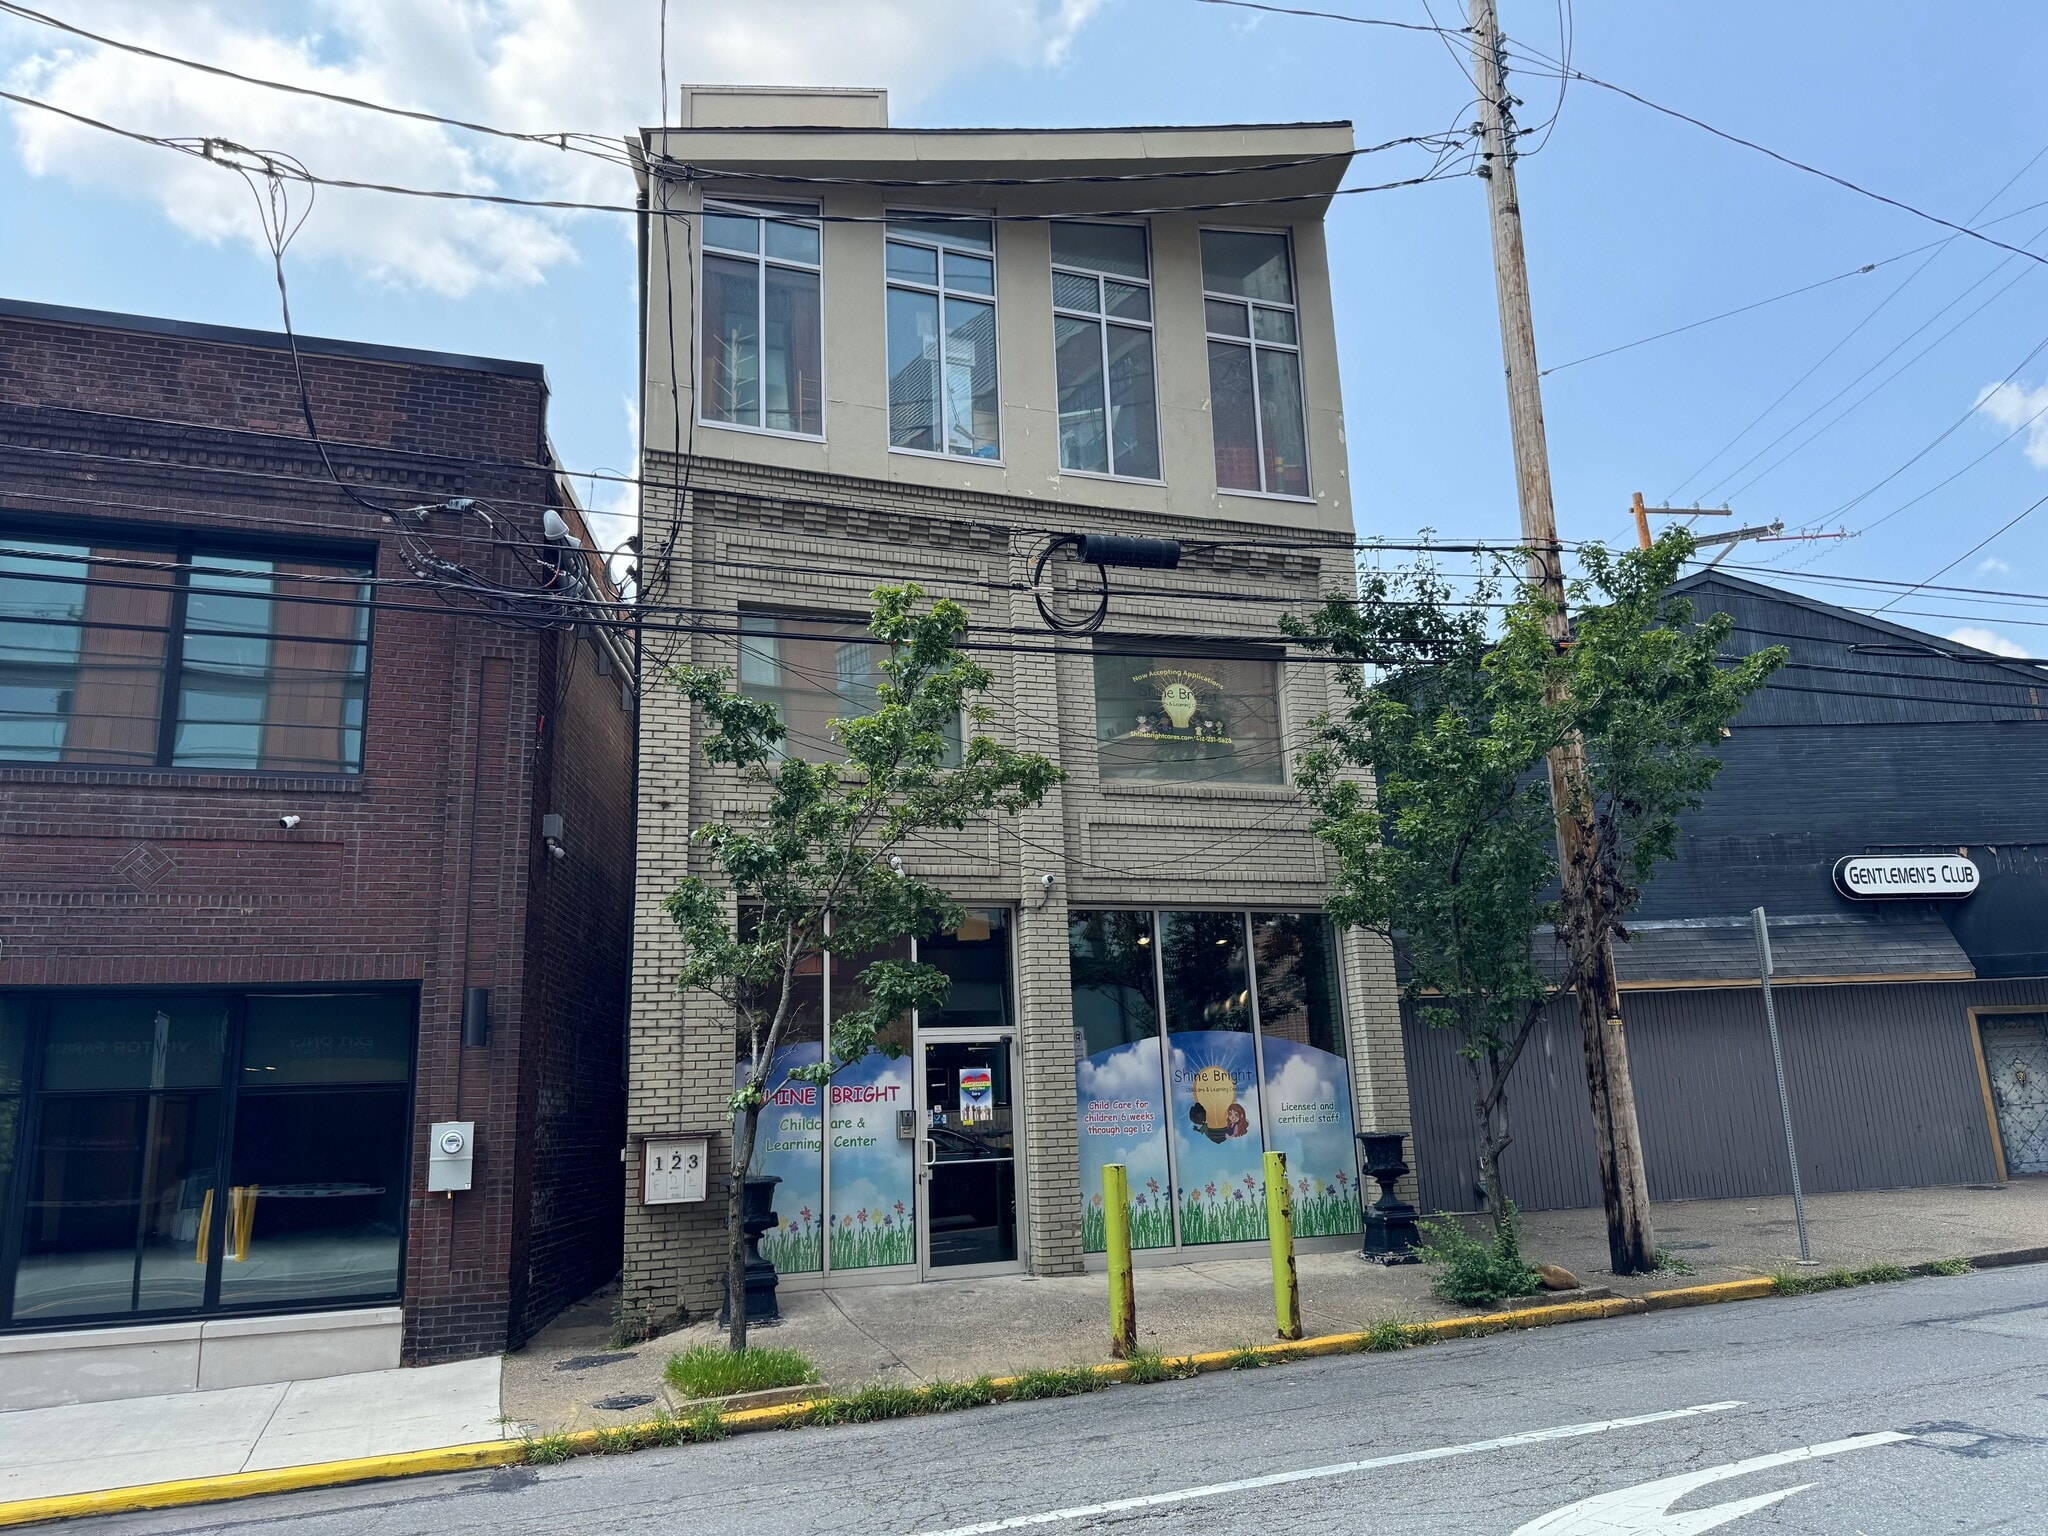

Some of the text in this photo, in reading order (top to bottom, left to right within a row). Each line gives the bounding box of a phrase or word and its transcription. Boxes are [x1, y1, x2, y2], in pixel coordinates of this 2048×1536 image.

[1132, 674, 1148, 683] Now
[1183, 670, 1224, 690] Applications
[1139, 684, 1175, 698] Shne
[1849, 865, 1974, 885] GENTLEMEN'S CLUB
[1174, 1067, 1252, 1085] Shine Bright
[832, 1085, 900, 1104] BRIGHT
[1089, 1099, 1148, 1110] Child Care for
[1281, 1101, 1334, 1111] Licensed and
[857, 1117, 865, 1128] &
[1084, 1112, 1154, 1122] children 6 weeks
[1278, 1113, 1340, 1124] certified staff
[1088, 1124, 1152, 1135] through age 12
[766, 1135, 877, 1152] Learning Center
